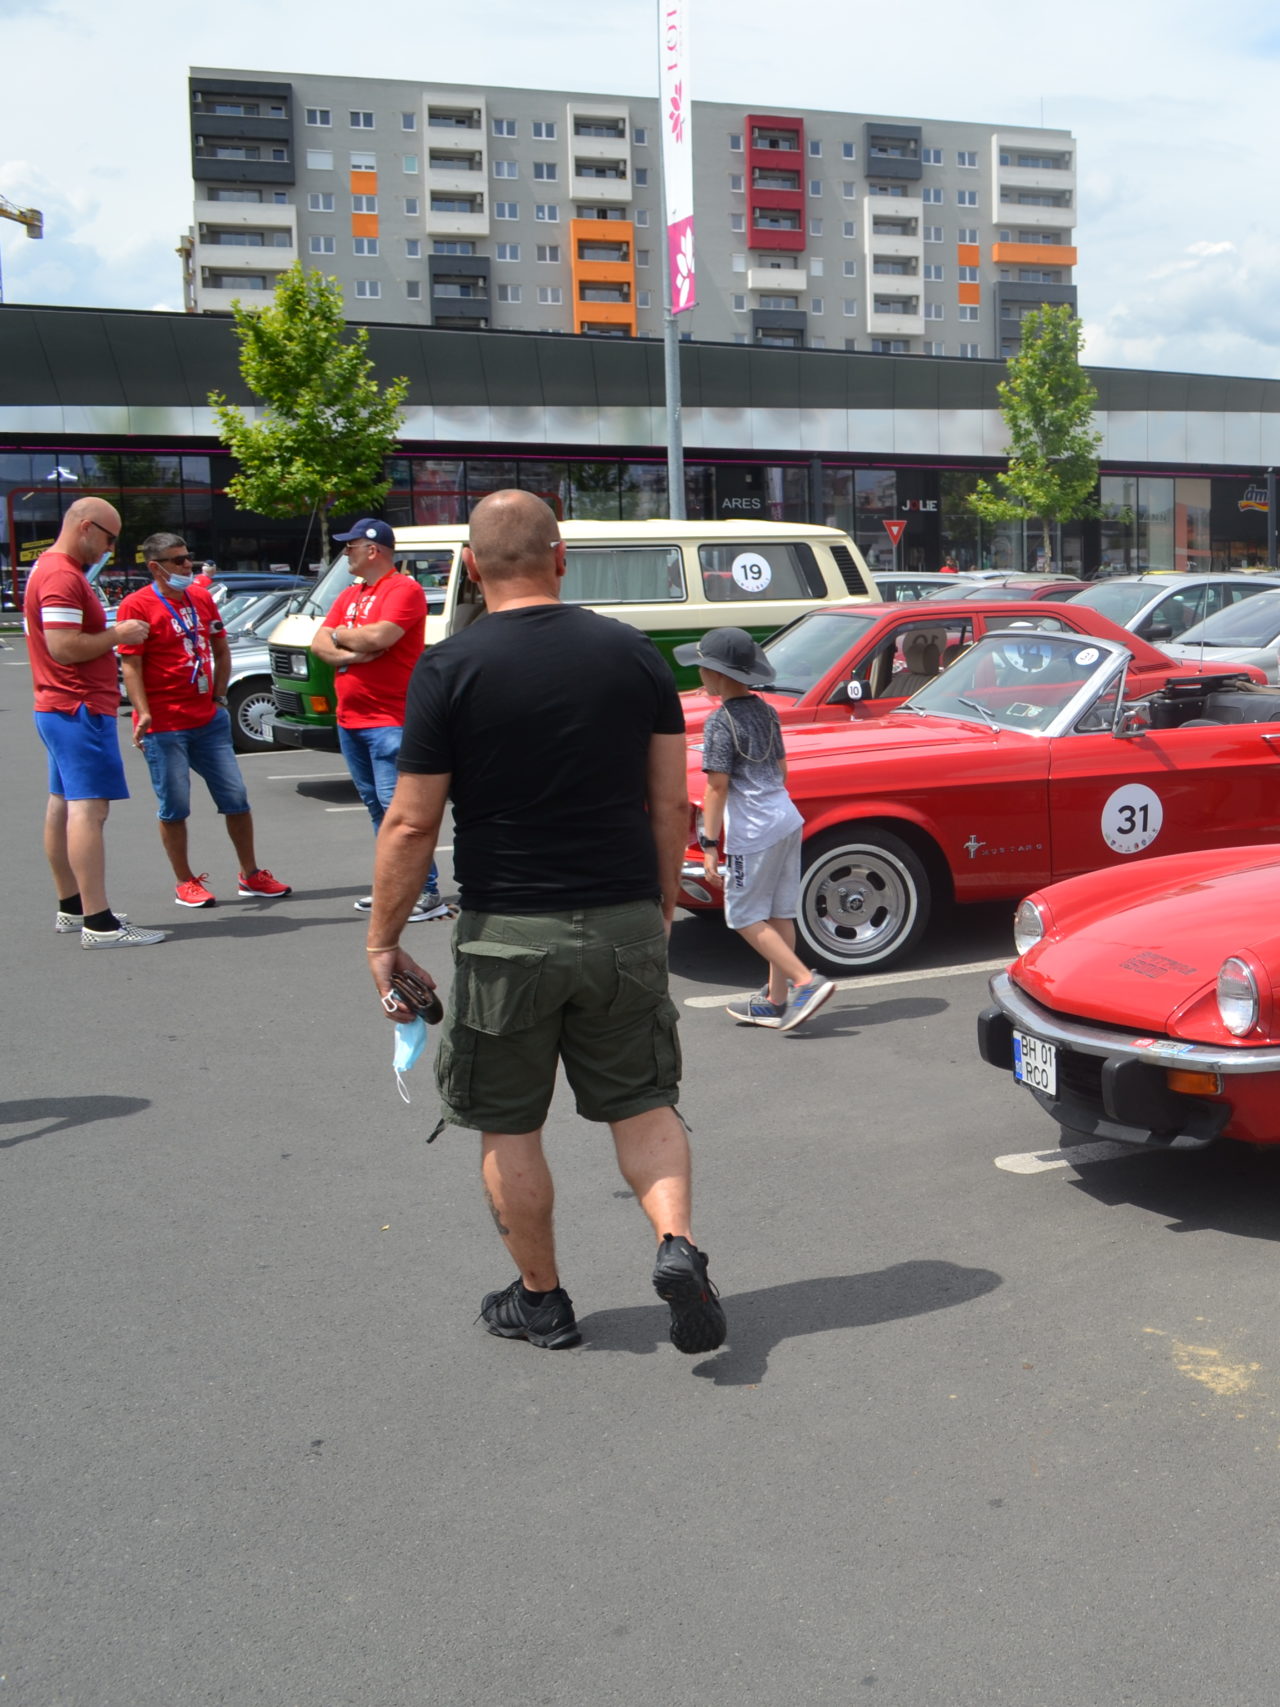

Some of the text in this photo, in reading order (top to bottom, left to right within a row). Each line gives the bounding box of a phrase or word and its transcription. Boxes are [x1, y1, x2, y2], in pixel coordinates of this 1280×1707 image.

[721, 497, 762, 510] ARES
[901, 499, 938, 512] JOLIE
[740, 563, 763, 581] 19
[849, 685, 860, 697] 10
[1116, 803, 1150, 835] 31
[1021, 1034, 1053, 1067] BH 01
[1025, 1060, 1049, 1089] RCO
